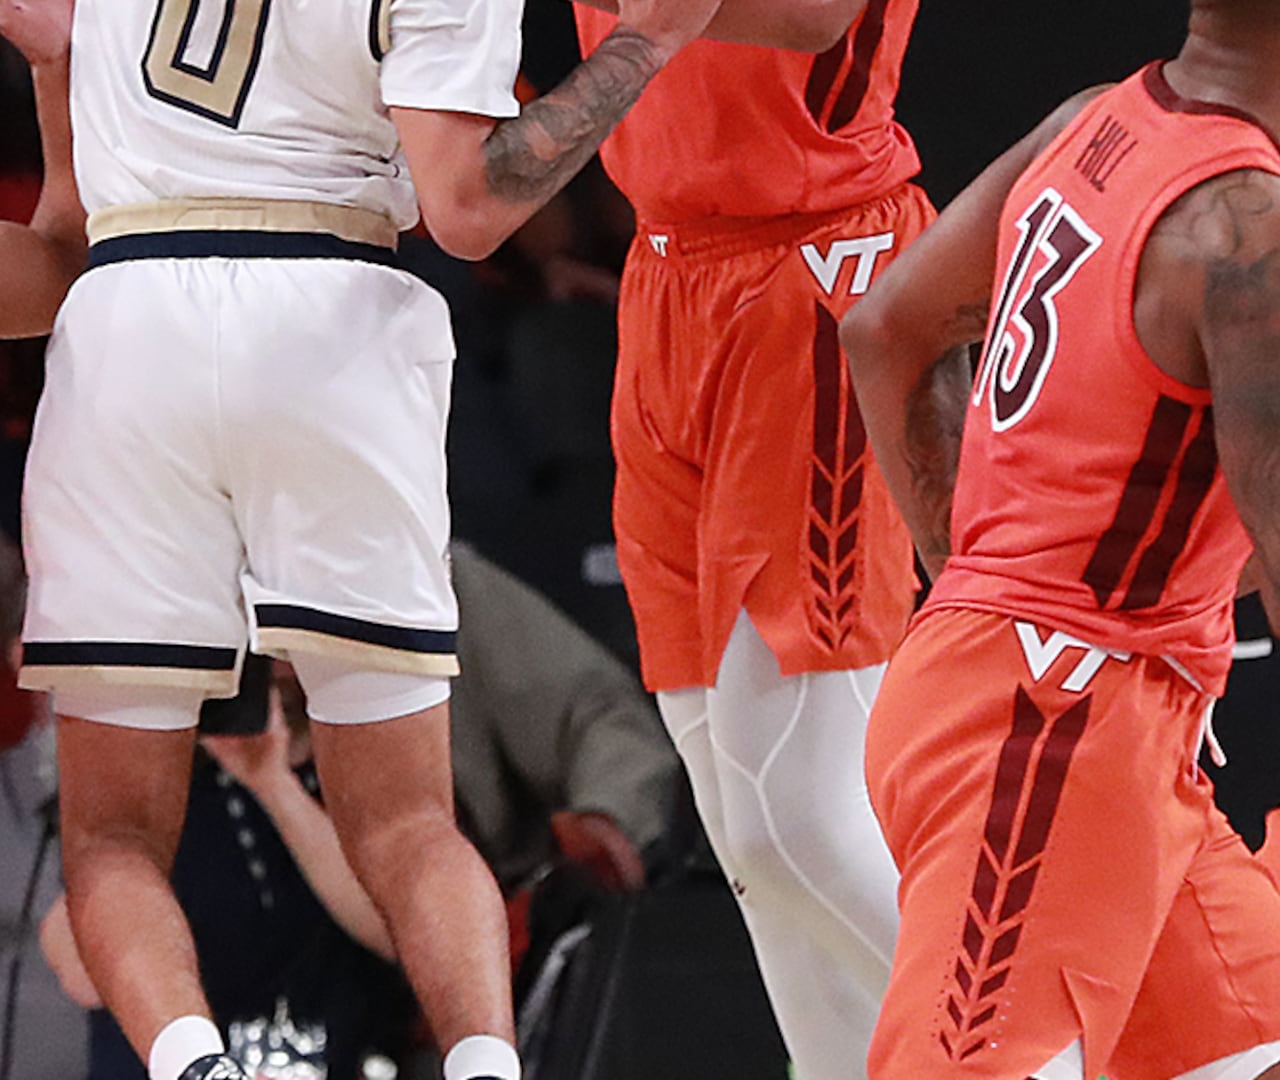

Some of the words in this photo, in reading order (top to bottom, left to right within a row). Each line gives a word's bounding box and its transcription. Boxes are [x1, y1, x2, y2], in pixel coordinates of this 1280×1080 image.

[1073, 114, 1139, 194] HILL
[799, 231, 895, 295] VT
[972, 186, 1104, 433] 13
[1013, 620, 1132, 692] VT
